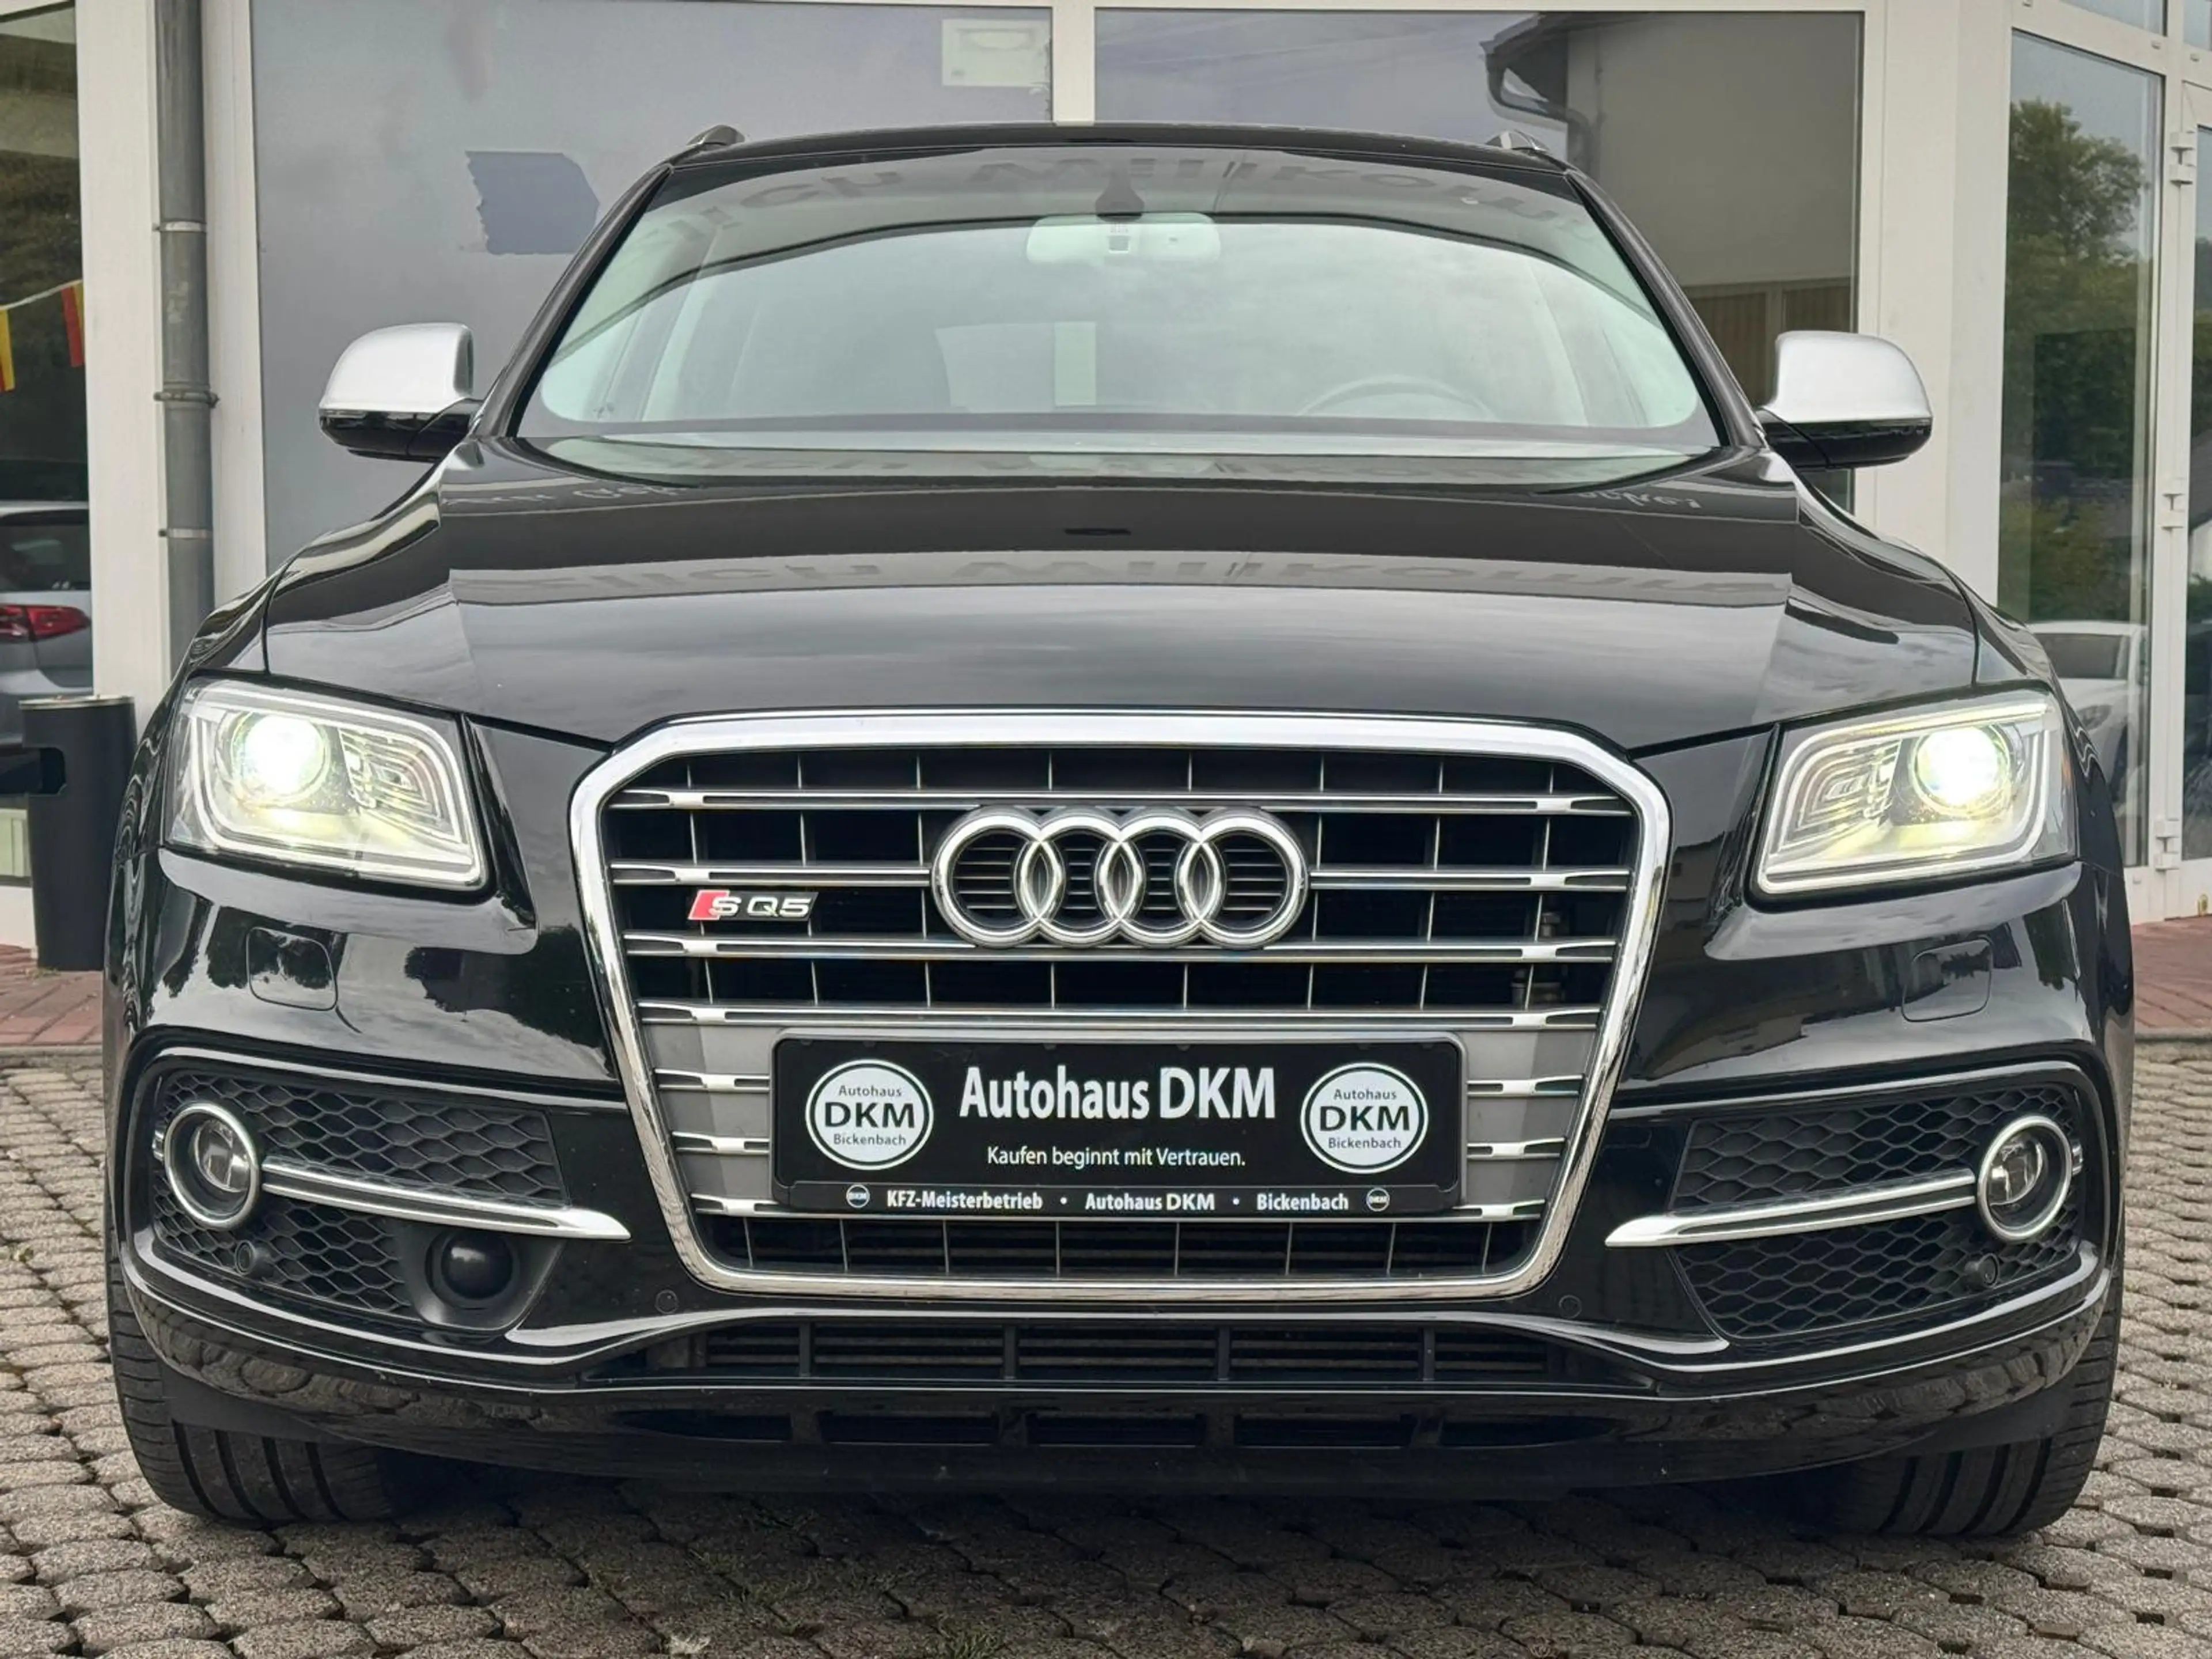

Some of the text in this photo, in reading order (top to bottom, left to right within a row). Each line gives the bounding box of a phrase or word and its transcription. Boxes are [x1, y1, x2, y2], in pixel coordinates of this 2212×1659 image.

[709, 896, 811, 917] SQ5
[838, 1085, 902, 1097] Autohaus
[960, 1065, 1275, 1119] Autohaus DKM
[1334, 1088, 1397, 1100] Autohaus
[825, 1101, 915, 1128] DKM
[1320, 1105, 1410, 1131] DKM
[834, 1134, 907, 1146] Bickenbach
[1328, 1137, 1402, 1149] Bickenbach
[987, 1146, 1245, 1169] Kaufen beginnt mit Vertrauen.
[887, 1190, 1043, 1209] KFZ-Meisterbetrieb
[1085, 1192, 1162, 1210] Autohaus
[1166, 1193, 1215, 1210] DKM
[1257, 1192, 1349, 1210] Bickenbach
